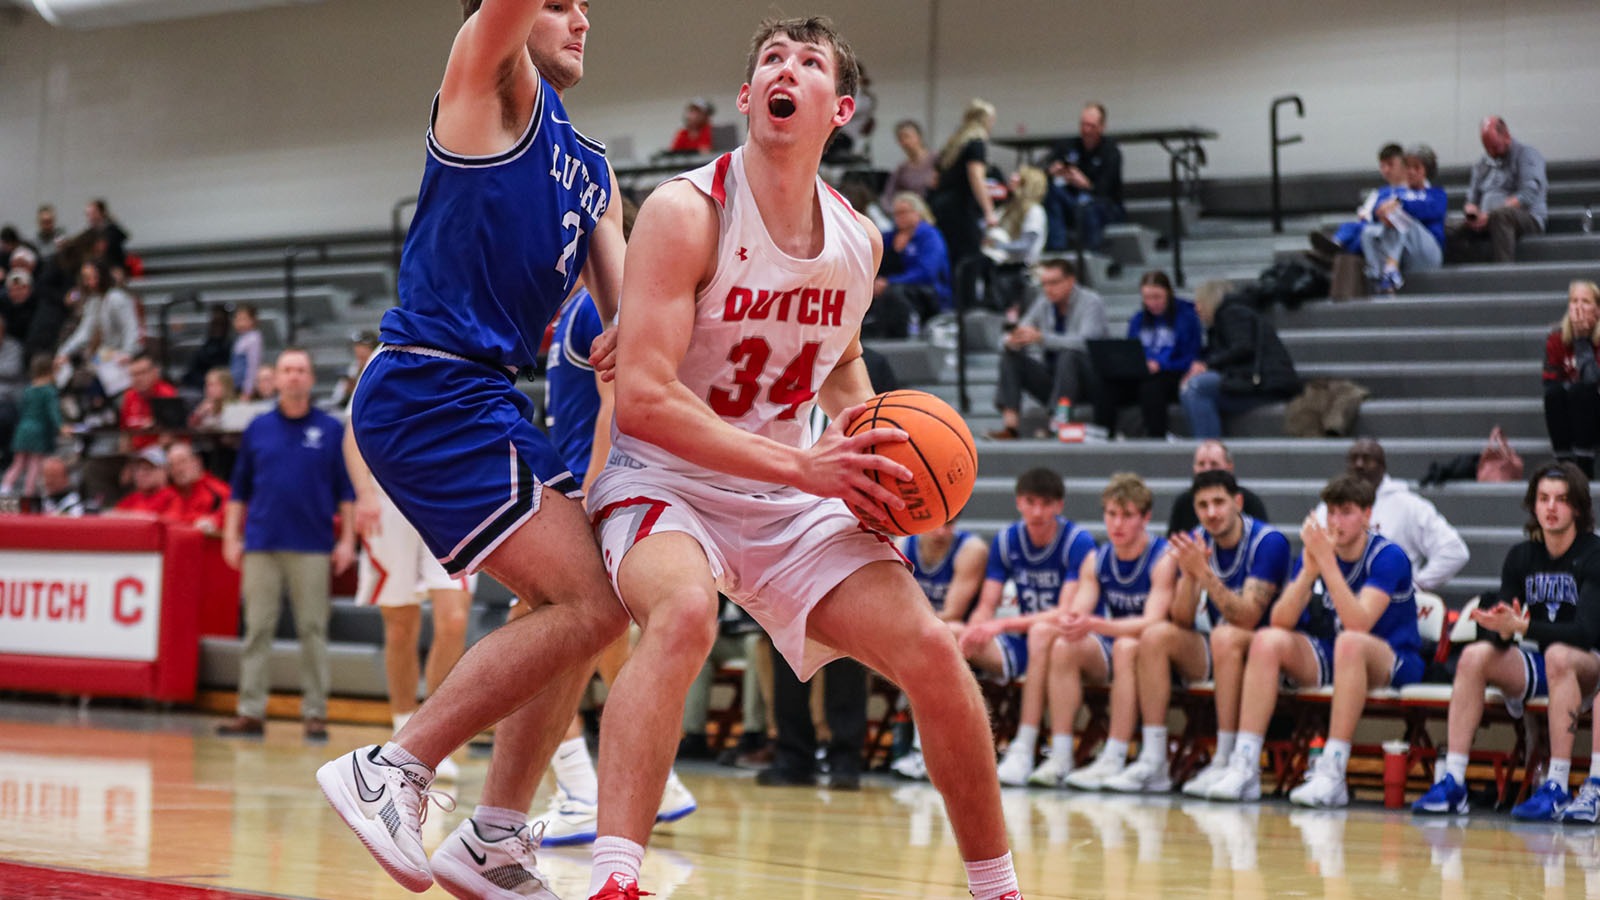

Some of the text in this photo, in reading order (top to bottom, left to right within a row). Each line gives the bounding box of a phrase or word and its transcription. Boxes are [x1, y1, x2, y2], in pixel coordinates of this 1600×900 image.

[722, 286, 847, 327] DUTCH
[706, 335, 823, 421] 34
[112, 577, 144, 627] C
